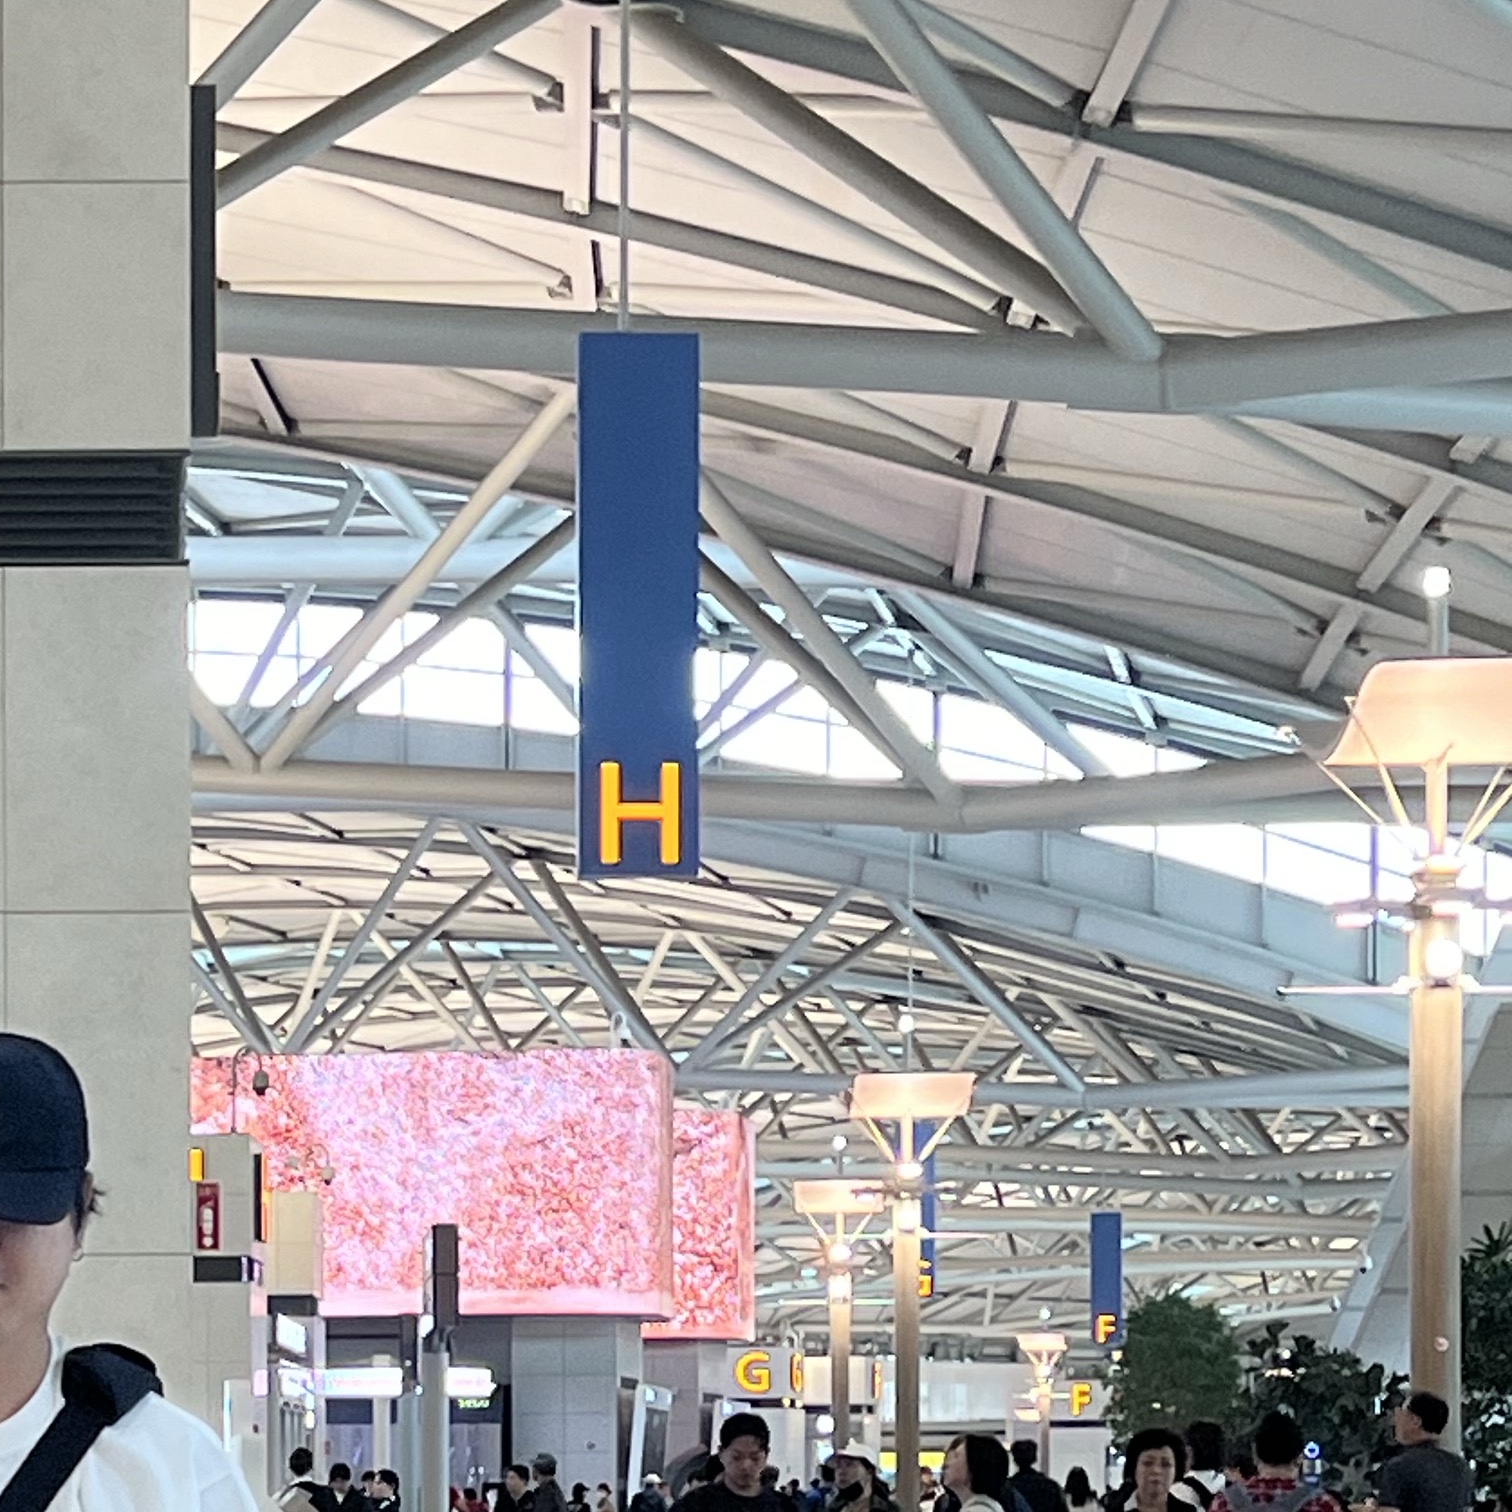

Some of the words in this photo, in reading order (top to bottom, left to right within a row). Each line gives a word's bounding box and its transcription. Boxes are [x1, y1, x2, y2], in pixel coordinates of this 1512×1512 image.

[600, 761, 680, 865] H
[1095, 1314, 1116, 1344] F
[735, 1350, 770, 1393] G
[1072, 1383, 1092, 1416] F
